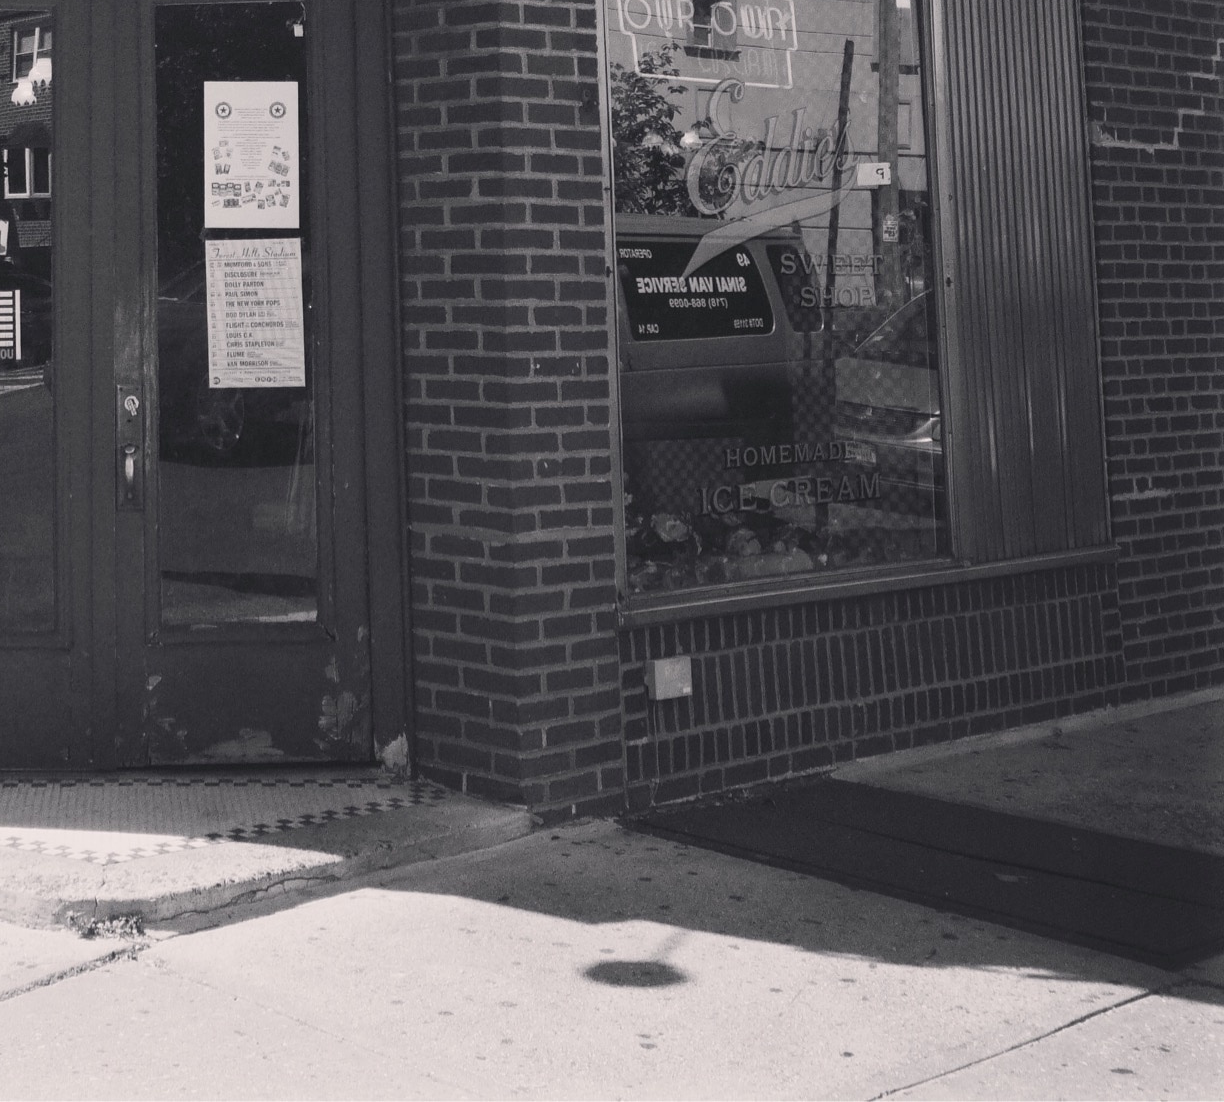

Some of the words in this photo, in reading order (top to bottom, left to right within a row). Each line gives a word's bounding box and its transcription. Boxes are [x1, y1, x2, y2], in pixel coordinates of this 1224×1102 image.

[687, 78, 858, 216] Eddie's
[780, 253, 883, 276] SWEET
[800, 285, 877, 309] SHOP
[725, 441, 858, 468] HOMEMADE
[697, 485, 758, 516] ICE
[769, 472, 882, 507] CREAM
